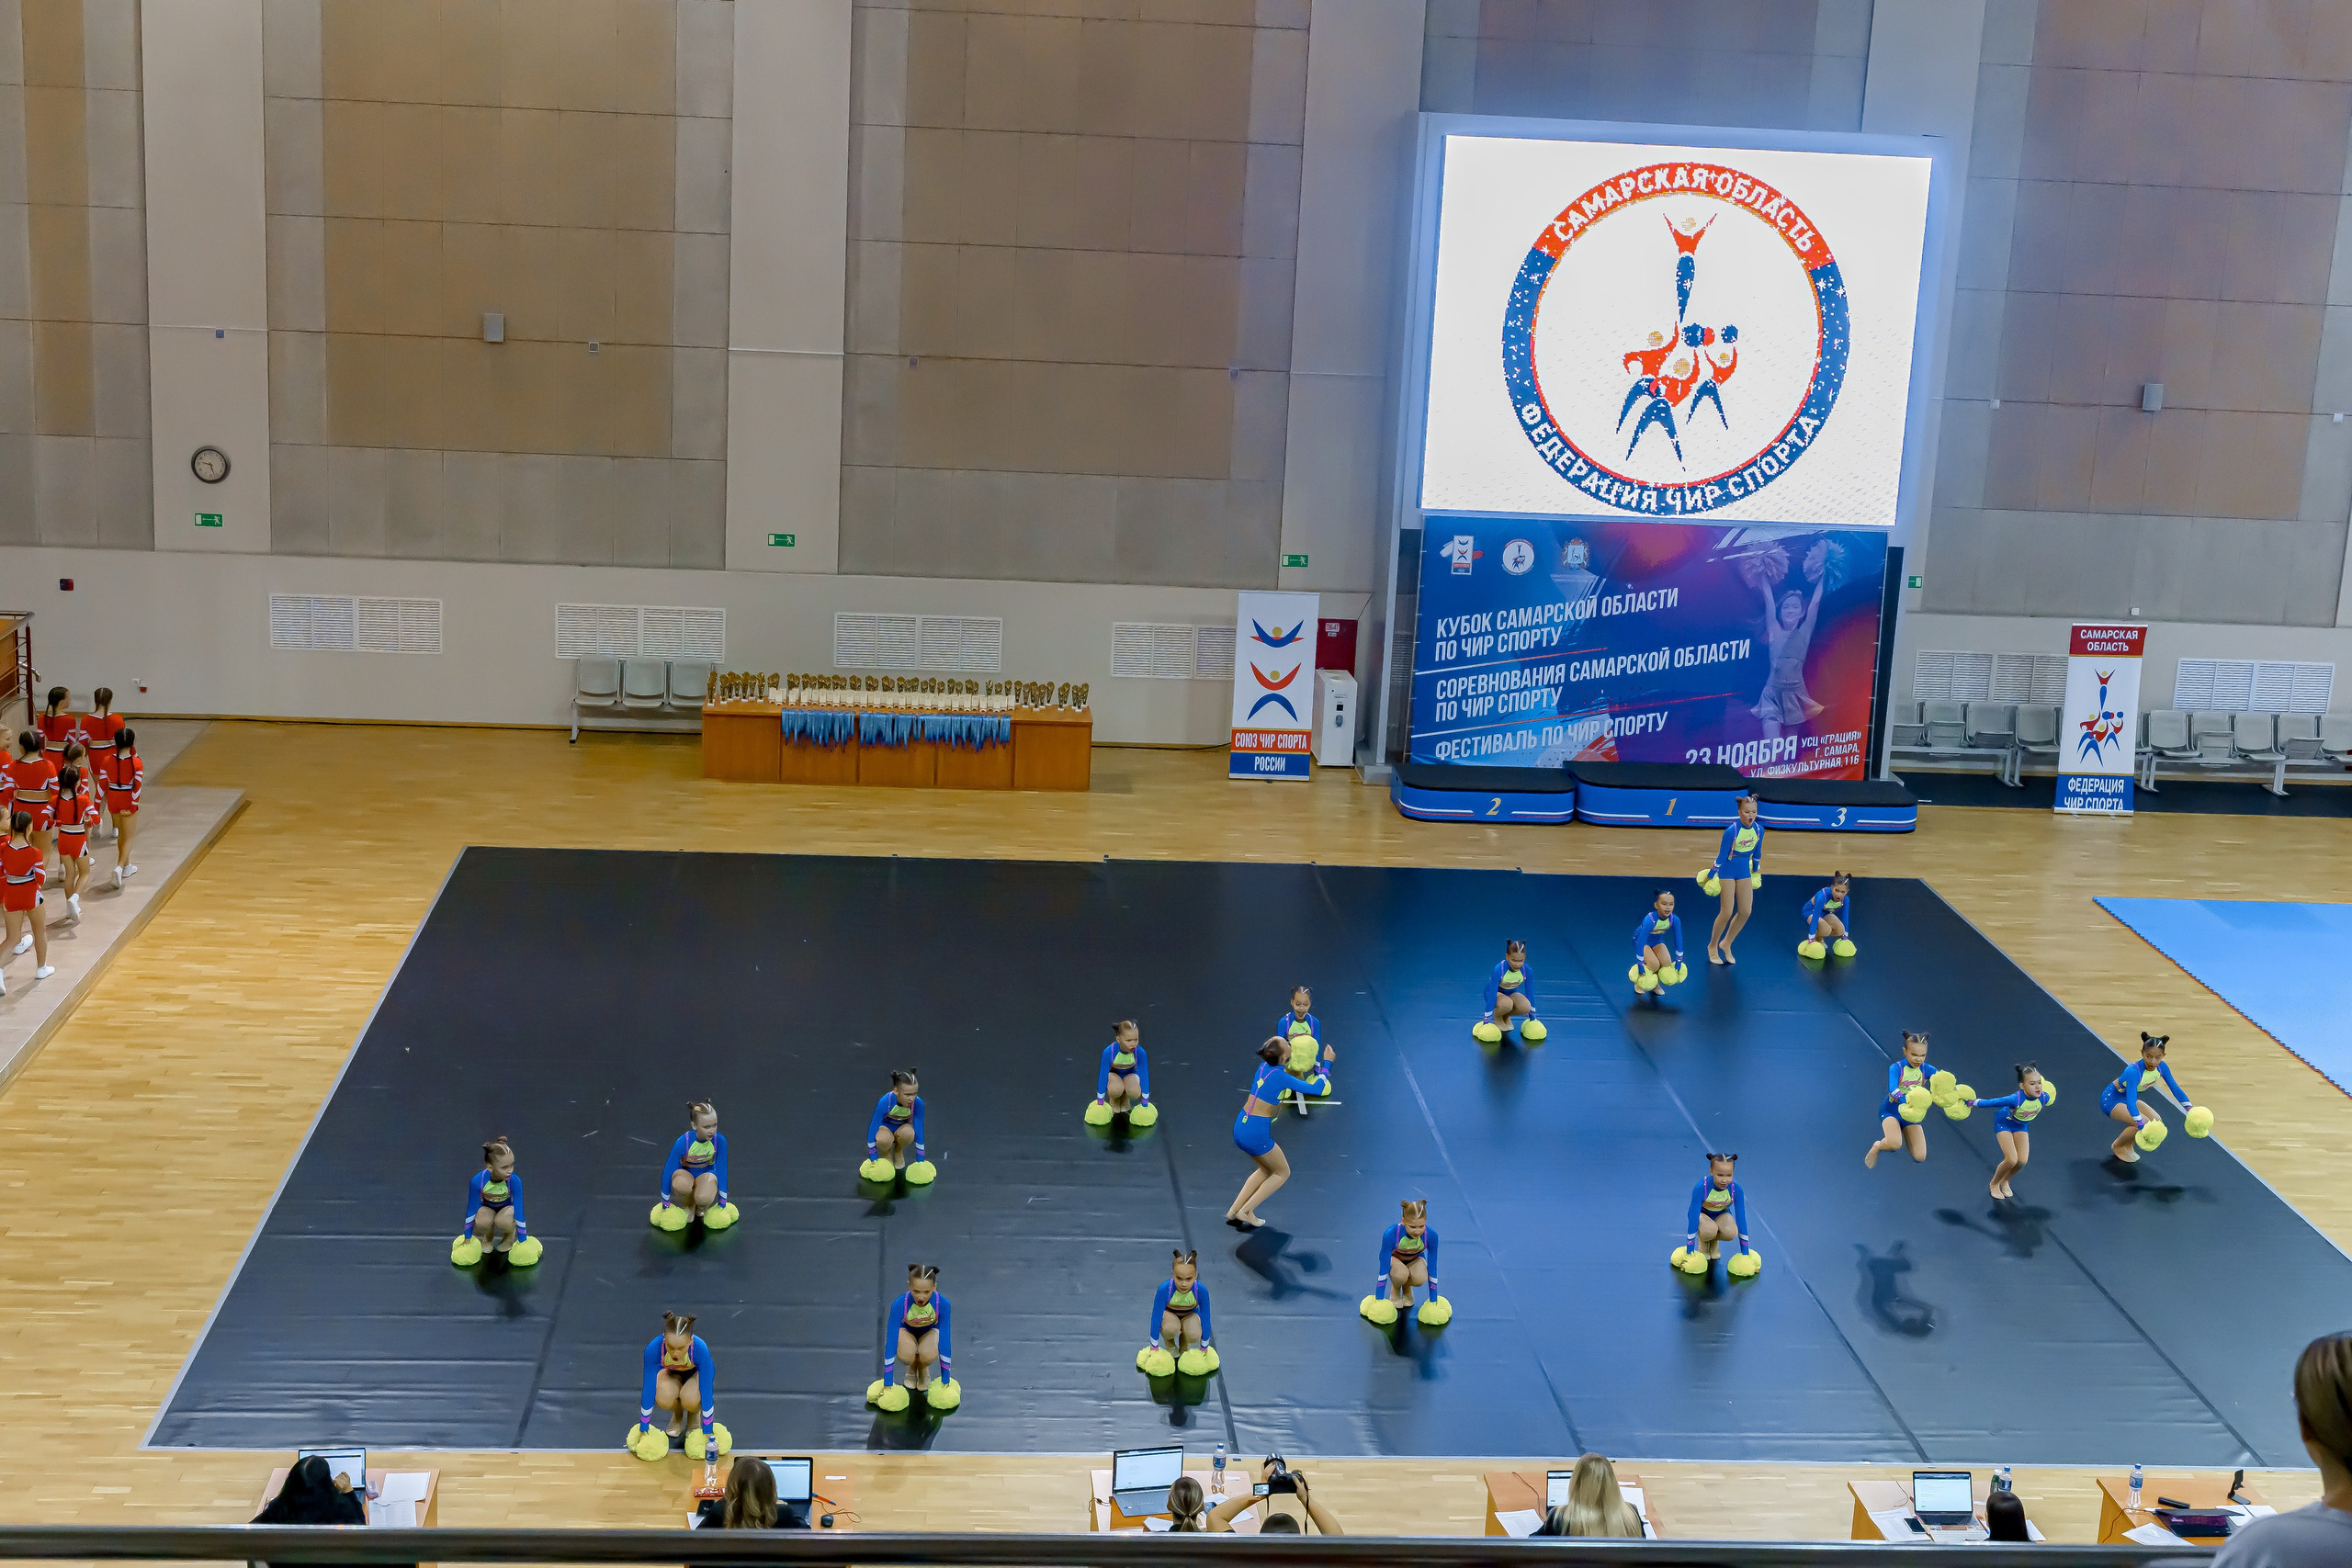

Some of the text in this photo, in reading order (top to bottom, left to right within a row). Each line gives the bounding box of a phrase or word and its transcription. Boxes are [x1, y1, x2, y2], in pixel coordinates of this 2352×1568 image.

[1552, 166, 1816, 254] САМАРСКАЯ ОБЛАСТЬ
[1521, 403, 1823, 512] ФЕДЕРАЦИЯ ЧИР СПОРТА
[1436, 587, 1679, 638] КУБОК САМАРСКОЙ ОБЛАСТИ
[1434, 626, 1564, 661] ПО ЧИР СПОРТУ
[2080, 629, 2139, 640] САМАРСКАЯ
[2086, 641, 2130, 652] ОБЛАСТЬ
[1436, 638, 1751, 700] СОРЕВНОВАНИЯ САМАРСКОЙ ОБЛАСТИ
[1435, 686, 1564, 722] ПО ЧИР СПОРТУ
[1235, 732, 1307, 750] СОЮЗ ЧИР СПОРТА
[1435, 711, 1668, 761] ФЕСТИВАЛЬ ПО ЧИР СПОРТУ
[1801, 730, 1862, 749] УСЦ «ГРАЦИЯ»
[1685, 735, 1798, 768] 23 НОЯБРЯ
[1815, 748, 1823, 758] Г.
[1845, 755, 1860, 766] 116
[1254, 756, 1285, 772] РОССИИ
[2067, 777, 2125, 795] ФЕДЕРАЦИЯ
[1486, 797, 1502, 816] 2
[1665, 797, 1677, 816] 1
[2064, 796, 2124, 810] ЧИР СПОРТА
[1831, 807, 1849, 827] 3
